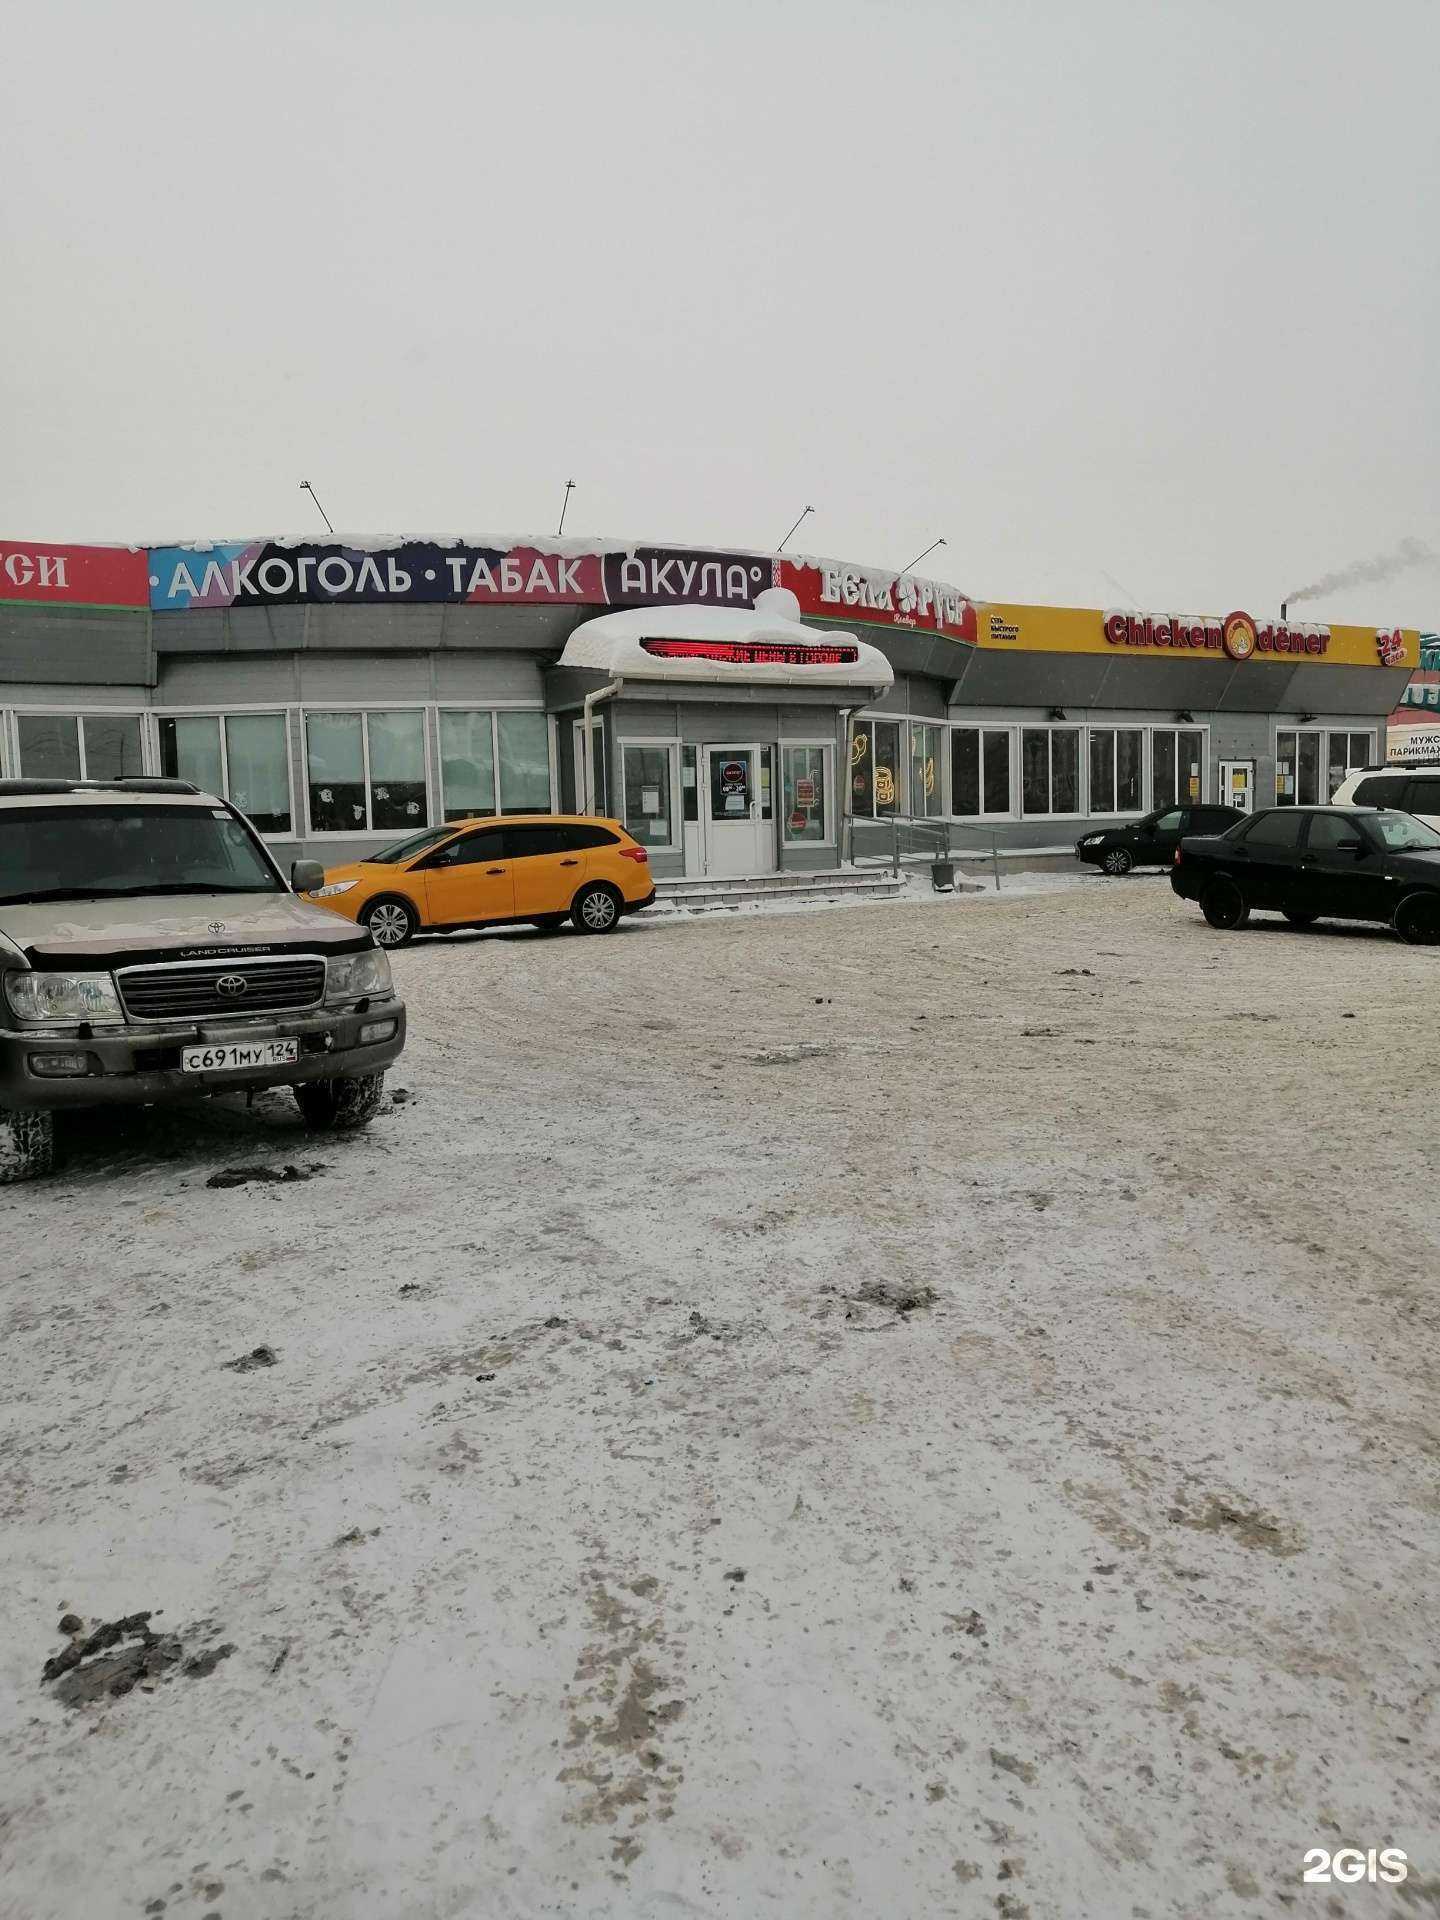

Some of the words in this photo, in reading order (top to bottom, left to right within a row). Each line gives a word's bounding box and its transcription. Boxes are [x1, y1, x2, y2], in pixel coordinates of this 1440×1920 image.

[0, 554, 69, 587] СИ
[167, 556, 412, 598] АЛКОГОЛЬ
[445, 557, 584, 594] ТАБАК
[991, 625, 1019, 633] БЫСТРОГО
[991, 633, 1017, 641] ПИТАНИЯ
[1105, 614, 1223, 648] Chicken
[1377, 628, 1402, 655] 24
[180, 949, 216, 957] LAND
[217, 946, 271, 954] CRUISER
[268, 1042, 295, 1057] 124
